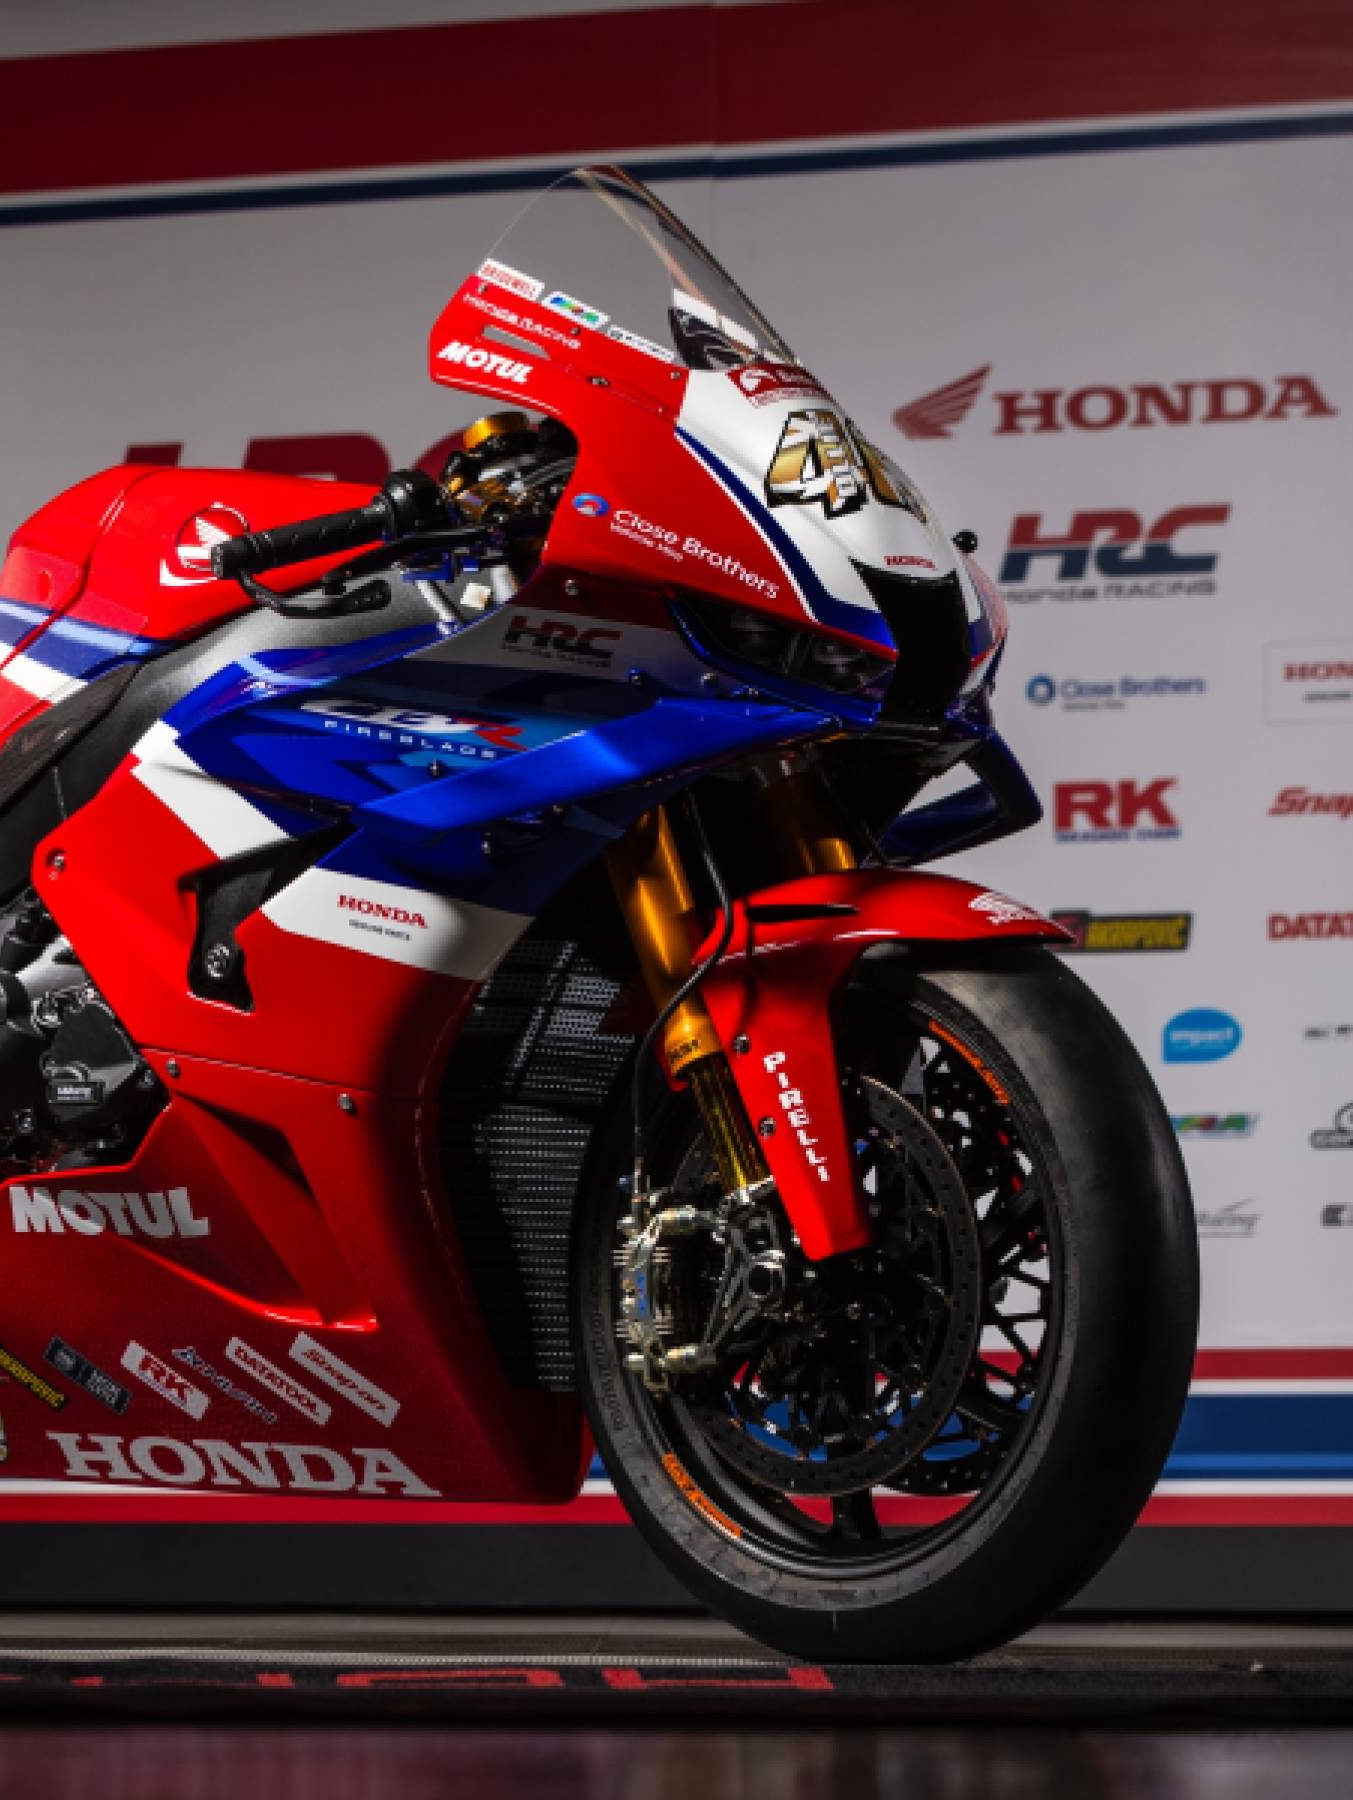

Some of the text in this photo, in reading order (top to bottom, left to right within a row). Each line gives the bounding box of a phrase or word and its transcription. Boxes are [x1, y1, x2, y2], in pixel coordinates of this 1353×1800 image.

[437, 341, 534, 384] MOTUL
[992, 374, 1338, 437] HONDA
[612, 509, 780, 599] Close Brothers
[999, 502, 1232, 583] HRC
[503, 615, 623, 659] HRC
[1119, 674, 1208, 695] Brothers
[324, 720, 497, 760] FIREBLADE
[1054, 774, 1179, 832] RK
[337, 894, 428, 930] HONDA
[763, 1051, 831, 1183] PIRELLI
[8, 1186, 211, 1238] MOTUL
[140, 1355, 188, 1401] RK
[46, 1431, 443, 1498] HONDA
